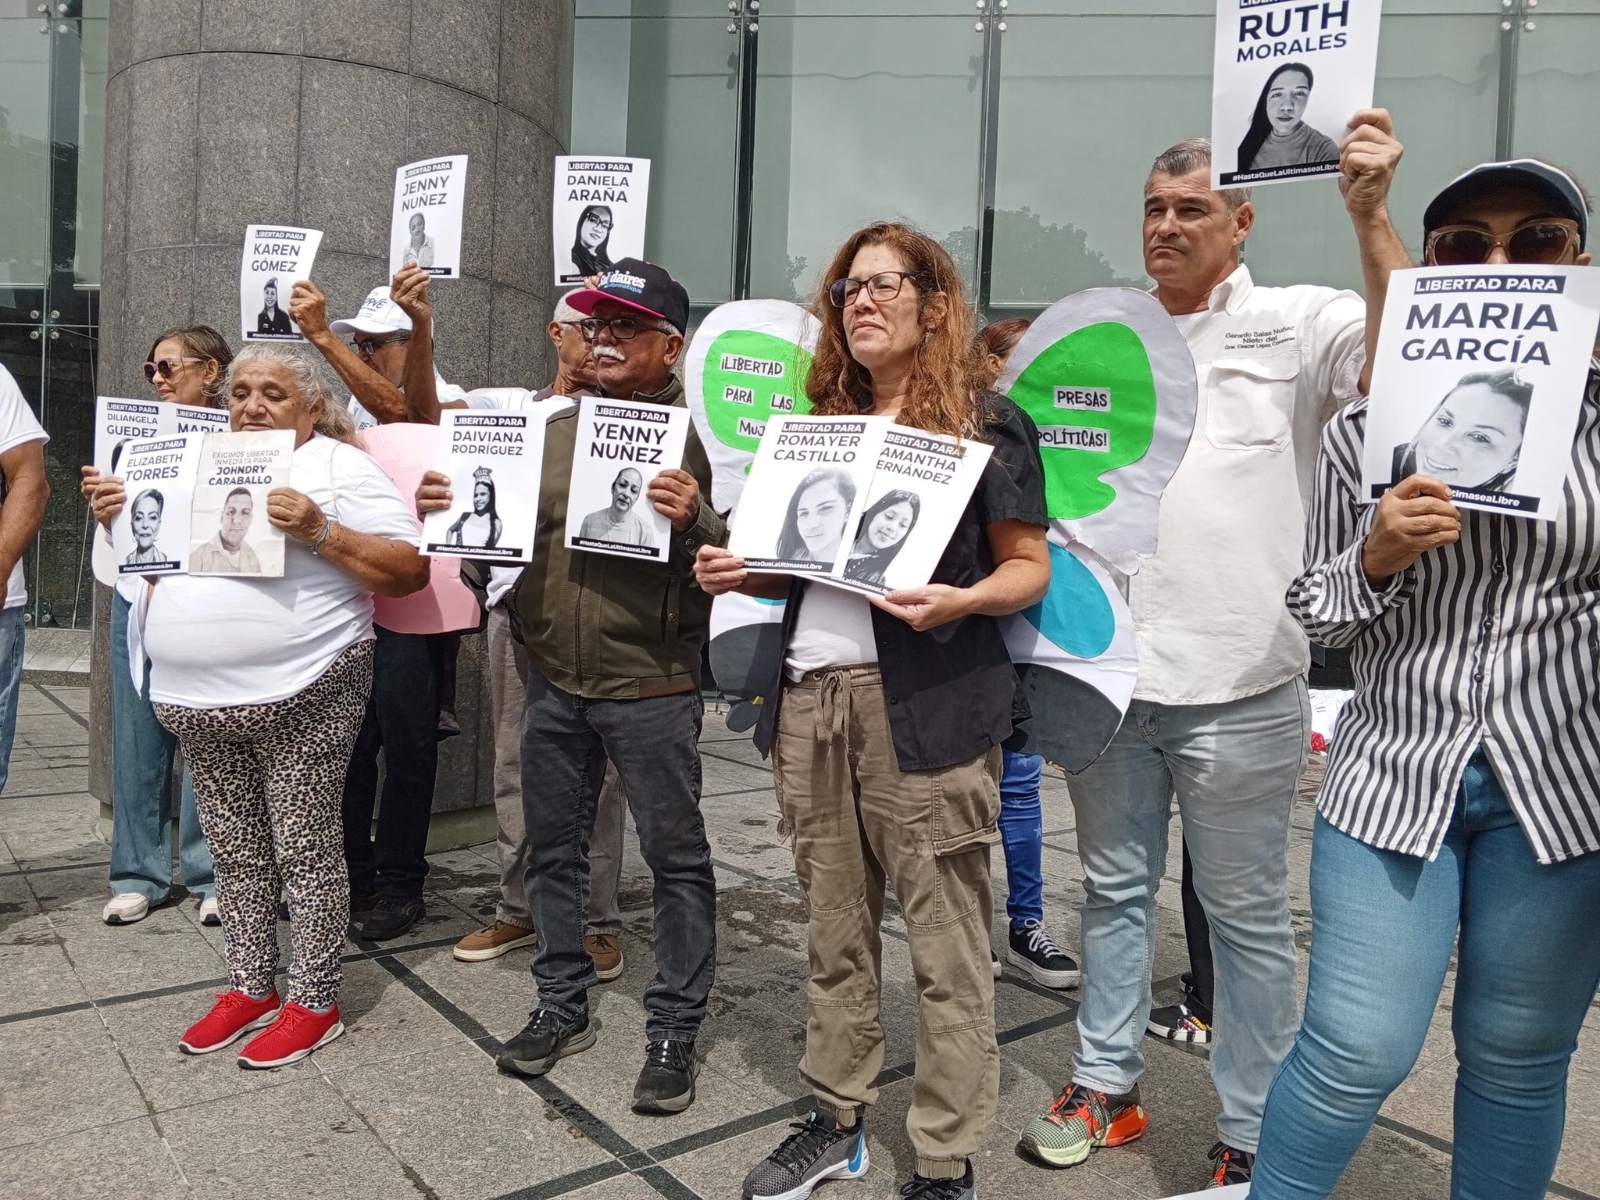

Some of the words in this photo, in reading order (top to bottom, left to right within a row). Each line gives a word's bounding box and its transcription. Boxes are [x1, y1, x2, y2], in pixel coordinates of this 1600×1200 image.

[1238, 0, 1350, 43] RUTH
[1236, 32, 1347, 63] MORALES
[405, 166, 432, 177] LIBERTAD
[568, 163, 606, 171] LIBERTAD
[402, 175, 450, 197] JENNY
[567, 175, 630, 187] DANIELA
[401, 192, 448, 212] NUÑEZ
[567, 187, 628, 203] ARAÑA
[255, 230, 285, 238] LIBERTAD
[285, 232, 304, 240] PARA
[253, 243, 301, 257] KAREN
[251, 258, 298, 272] GÓMEZ
[1415, 278, 1501, 292] LIBERTAD
[1506, 278, 1559, 291] PARA
[1405, 302, 1559, 332] MARIA
[1401, 334, 1551, 366] GARCÍA
[725, 387, 753, 404] PARA
[771, 394, 793, 411] LAS
[1057, 390, 1108, 408] PRESAS
[107, 402, 138, 413] LIBERTAD
[138, 406, 158, 414] PARA
[176, 409, 207, 420] LIBERTAD
[595, 406, 639, 419] LIBERTAD
[640, 412, 667, 422] PARA
[107, 413, 159, 425] DILIANGELA
[454, 417, 497, 426] LIBERTAD
[498, 418, 524, 426] PARA
[106, 425, 158, 438] GUEDEZ
[593, 422, 668, 445] YENNY
[781, 423, 832, 433] LIBERTAD
[833, 423, 862, 433] PARA
[452, 431, 524, 443] DAIVIANA
[776, 434, 861, 447] ROMAYER
[131, 441, 164, 454] LIBERTAD
[164, 440, 184, 449] PARA
[451, 443, 523, 456] RODRÍGUEZ
[590, 441, 663, 465] NUÑEZ
[931, 441, 961, 457] PARA
[127, 453, 183, 468] ELIZABETH
[212, 451, 245, 459] EXIGIMOS
[773, 449, 857, 463] CASTILLO
[880, 446, 957, 472] AMANTHA
[126, 466, 179, 482] TORRES
[216, 465, 267, 476] JOHNDRY
[876, 459, 953, 485] ERNÁNDEZ
[208, 475, 272, 486] CARABALLO
[744, 560, 823, 570] HastaQueLaUltimaseaLibre
